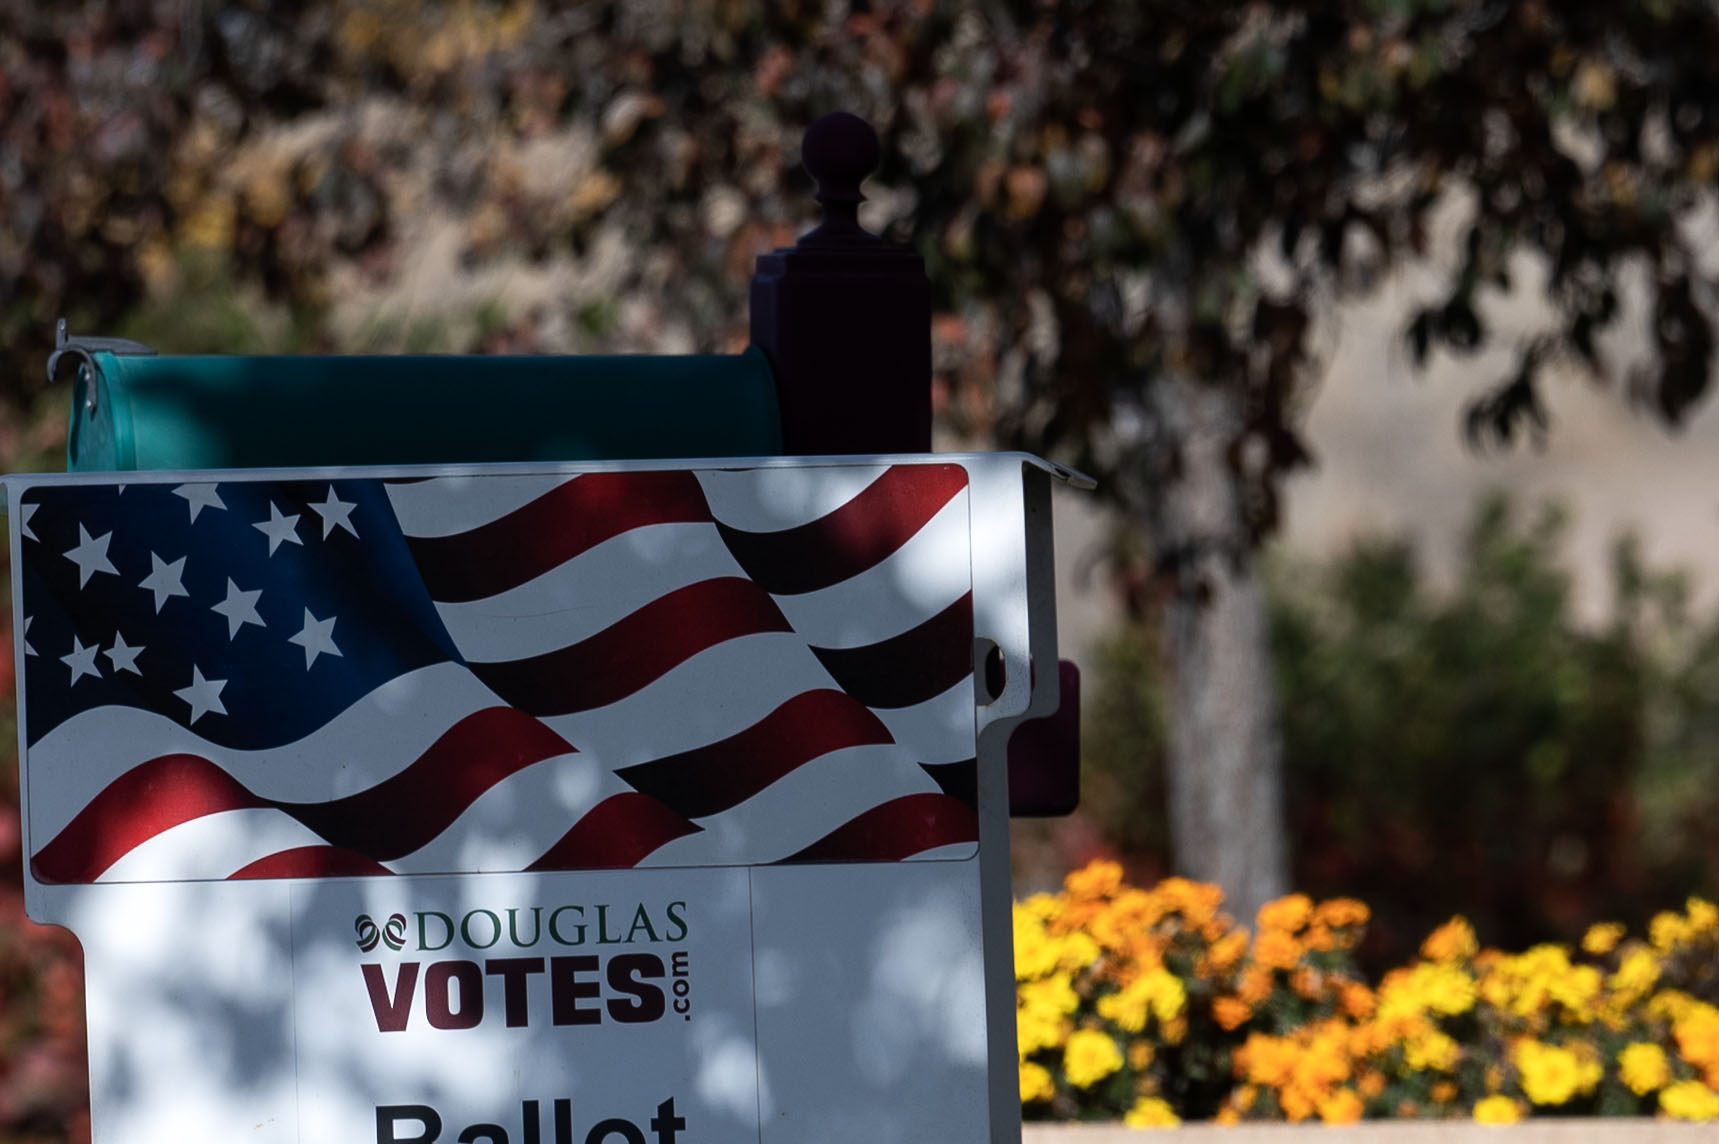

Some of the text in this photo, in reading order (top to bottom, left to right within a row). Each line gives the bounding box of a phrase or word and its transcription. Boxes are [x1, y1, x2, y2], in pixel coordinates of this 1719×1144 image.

[413, 901, 689, 952] DOUGLAS
[360, 953, 666, 1032] VOTES
[671, 951, 691, 1022] .com
